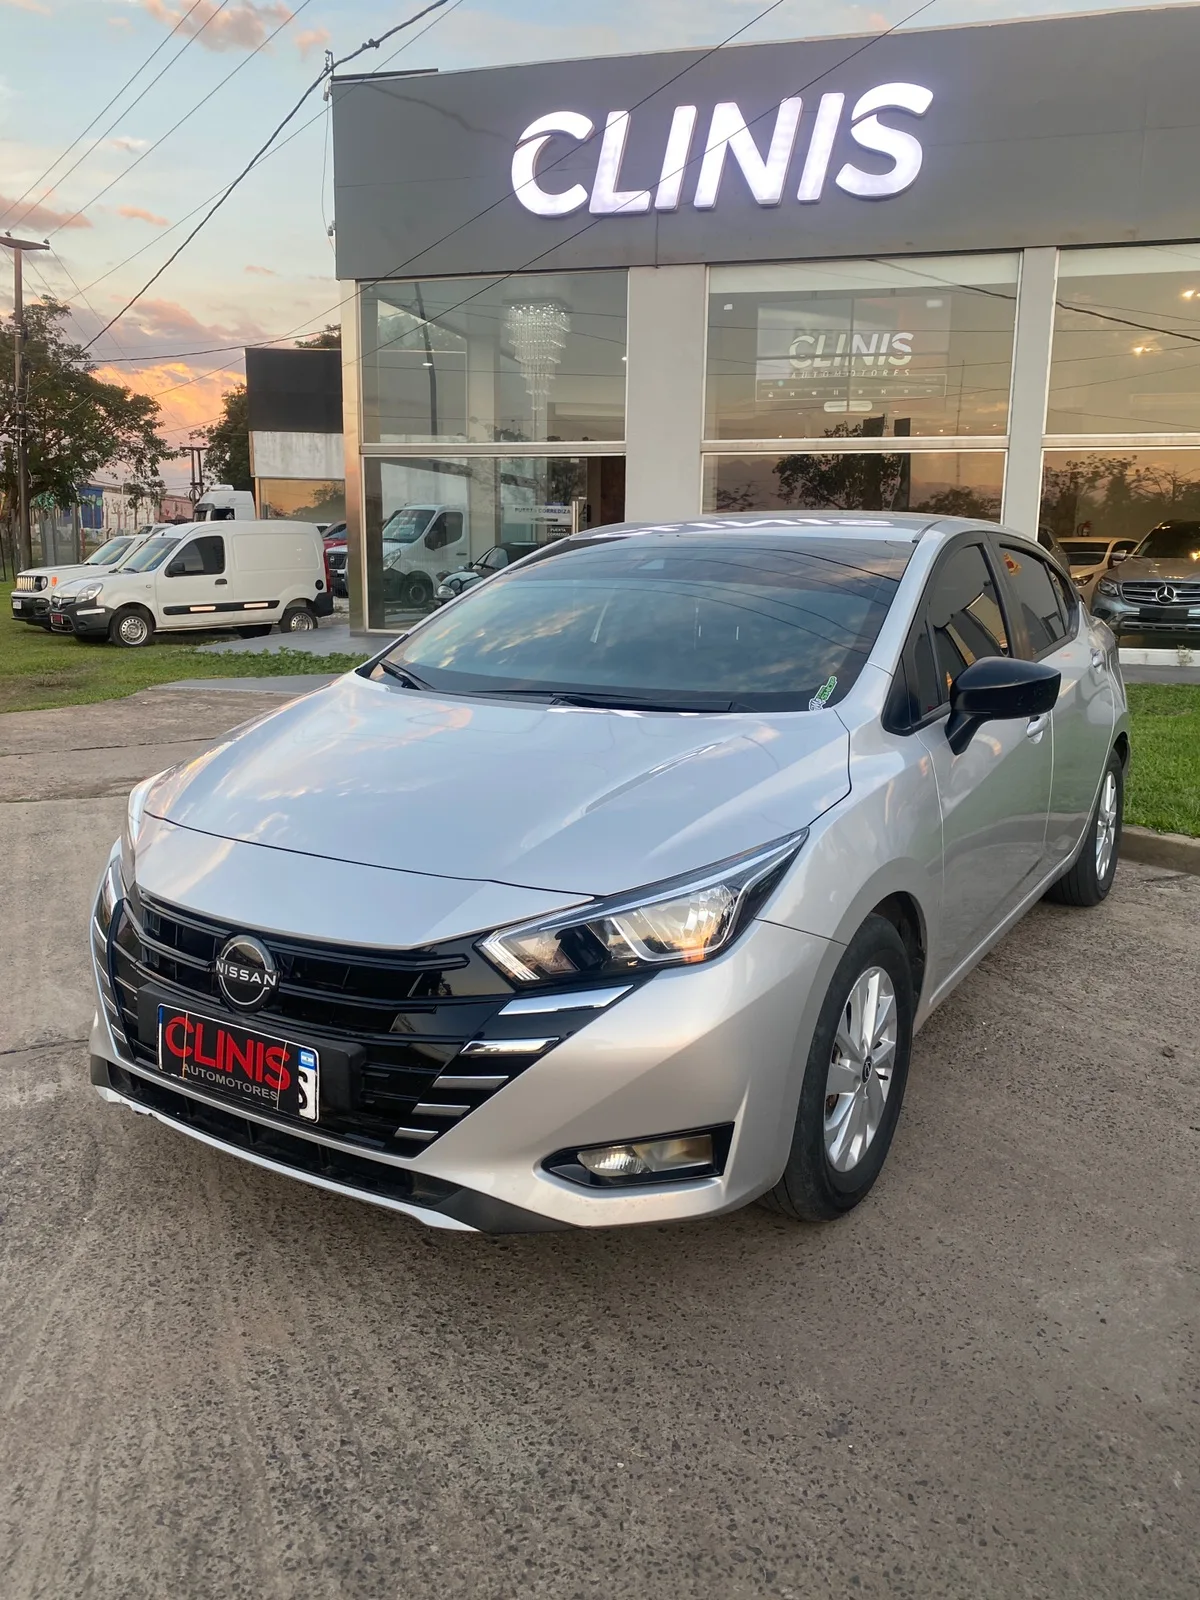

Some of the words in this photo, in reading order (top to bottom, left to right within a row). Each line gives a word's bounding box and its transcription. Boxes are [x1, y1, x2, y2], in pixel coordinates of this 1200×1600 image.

[510, 81, 934, 217] CLINIS
[789, 332, 914, 369] CLINIS
[215, 960, 277, 986] NISSAN
[164, 1016, 291, 1091] CLINIS
[182, 1063, 279, 1101] AUTOMOTORES
